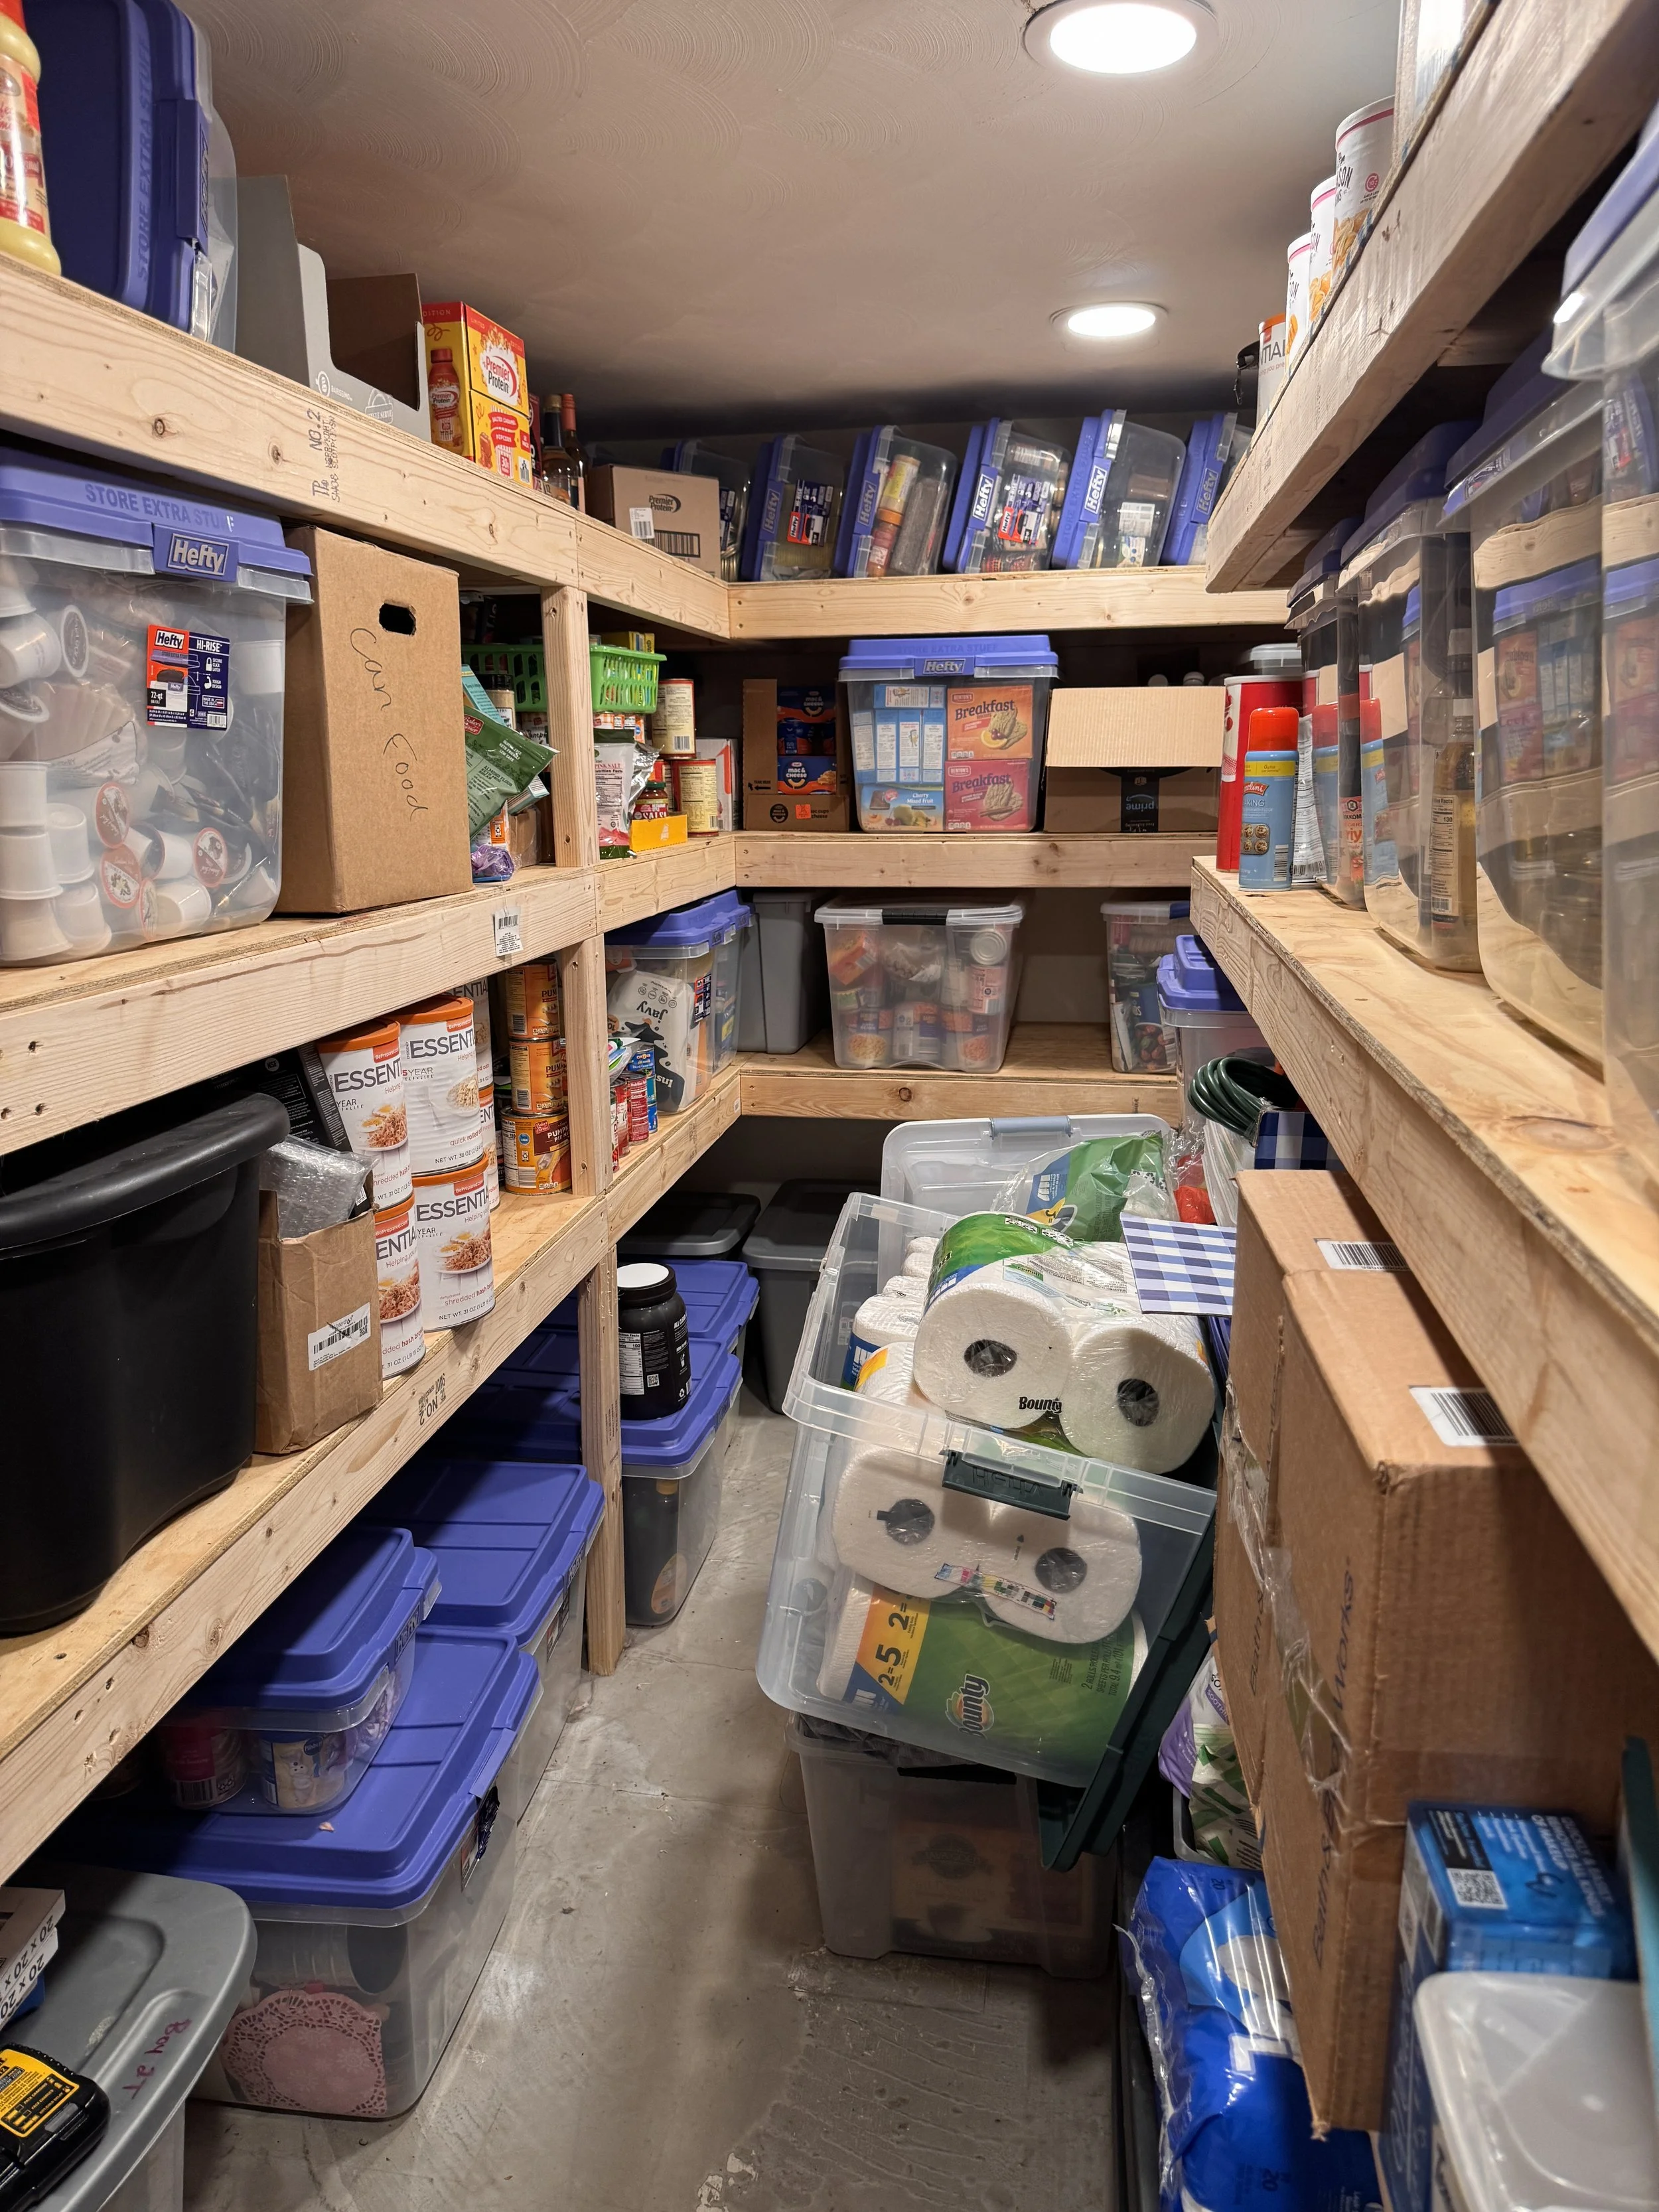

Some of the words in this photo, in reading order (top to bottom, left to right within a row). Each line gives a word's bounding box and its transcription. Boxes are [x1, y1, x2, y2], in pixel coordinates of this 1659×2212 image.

[138, 120, 153, 192] EXTRA
[486, 355, 510, 382] Premier
[488, 370, 510, 394] Protein
[975, 478, 993, 518] Hefty
[1087, 467, 1106, 512] Hefty
[1198, 471, 1218, 513] Hefty
[84, 483, 137, 512] STORE
[142, 497, 192, 525] EXTRA
[648, 495, 674, 505] Premier
[650, 503, 674, 512] Protein
[859, 484, 877, 524] Hefty
[764, 492, 779, 530] Hefty
[1002, 512, 1012, 532] Hefty
[172, 539, 225, 573] Hefty
[157, 631, 183, 649] Hefty
[196, 638, 221, 653] HI-RISE
[925, 659, 963, 674] Hefty
[955, 700, 1015, 721] Breakfast
[952, 772, 1012, 794] Breakfast
[1125, 800, 1155, 812] prime
[636, 1000, 669, 1023] javy
[407, 1067, 433, 1076] YEAR
[336, 1098, 357, 1108] YEAR
[450, 1138, 466, 1147] quick
[465, 1211, 483, 1223] Helping
[417, 1227, 436, 1236] YEAR
[386, 1254, 407, 1269] Helping
[445, 1293, 476, 1306] shredded
[476, 1286, 487, 1297] hash
[401, 1336, 414, 1349] hash
[387, 1361, 394, 1369] 31
[959, 1674, 989, 1739] Bounty
[1537, 1827, 1569, 1871] MAKEUP
[39, 1918, 54, 1937] 20
[29, 1956, 46, 1980] 20
[32, 2082, 48, 2097] CHARGING
[39, 2089, 54, 2102] CHARGED
